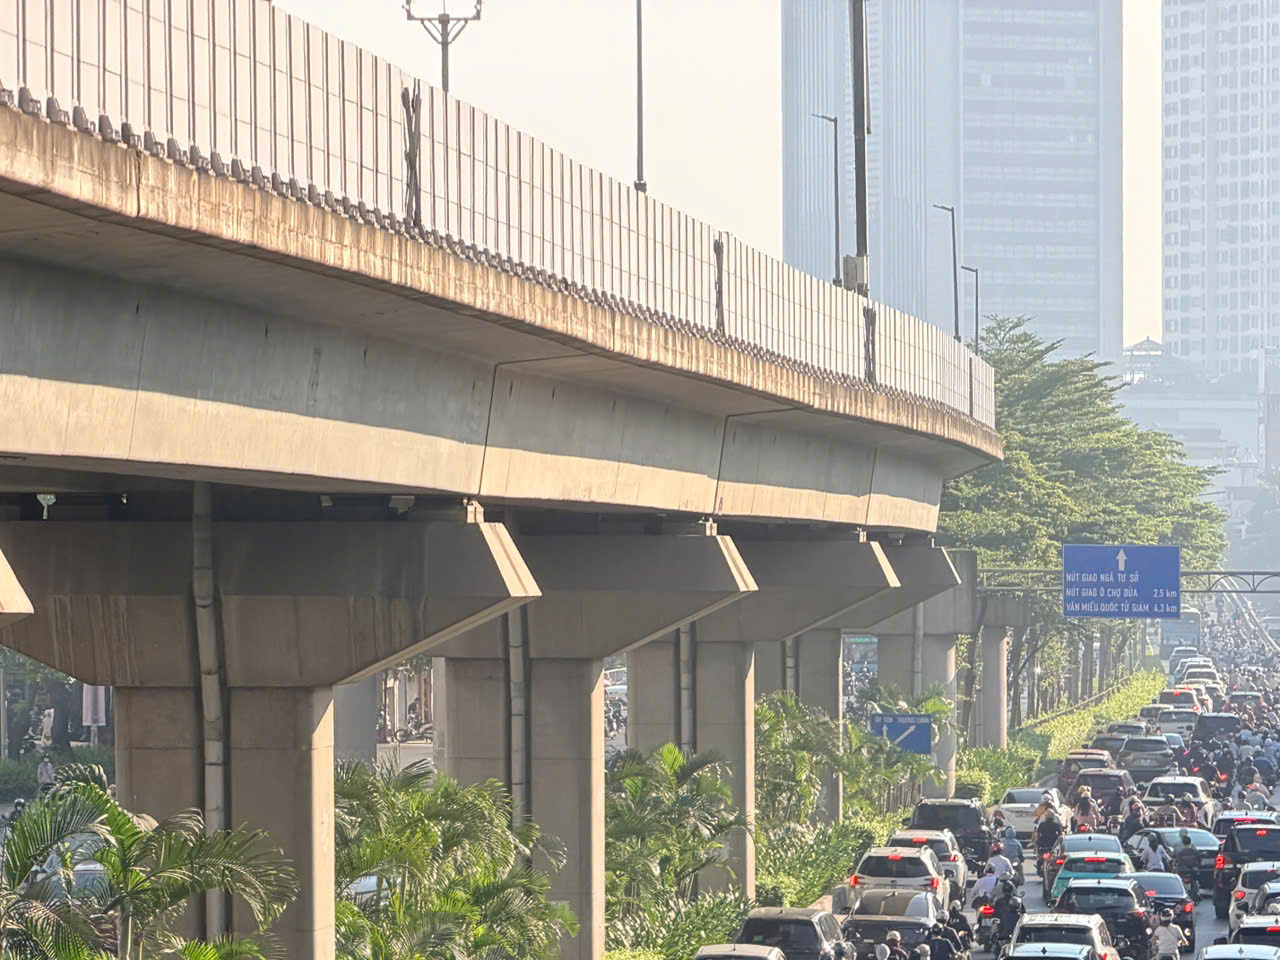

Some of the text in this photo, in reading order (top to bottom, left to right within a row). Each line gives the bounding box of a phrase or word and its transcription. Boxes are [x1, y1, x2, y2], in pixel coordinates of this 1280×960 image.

[1082, 574, 1097, 582] GIAO
[1153, 589, 1164, 598] 2.5
[1166, 589, 1177, 598] km
[1154, 604, 1165, 612] 4.3
[1166, 603, 1177, 612] km
